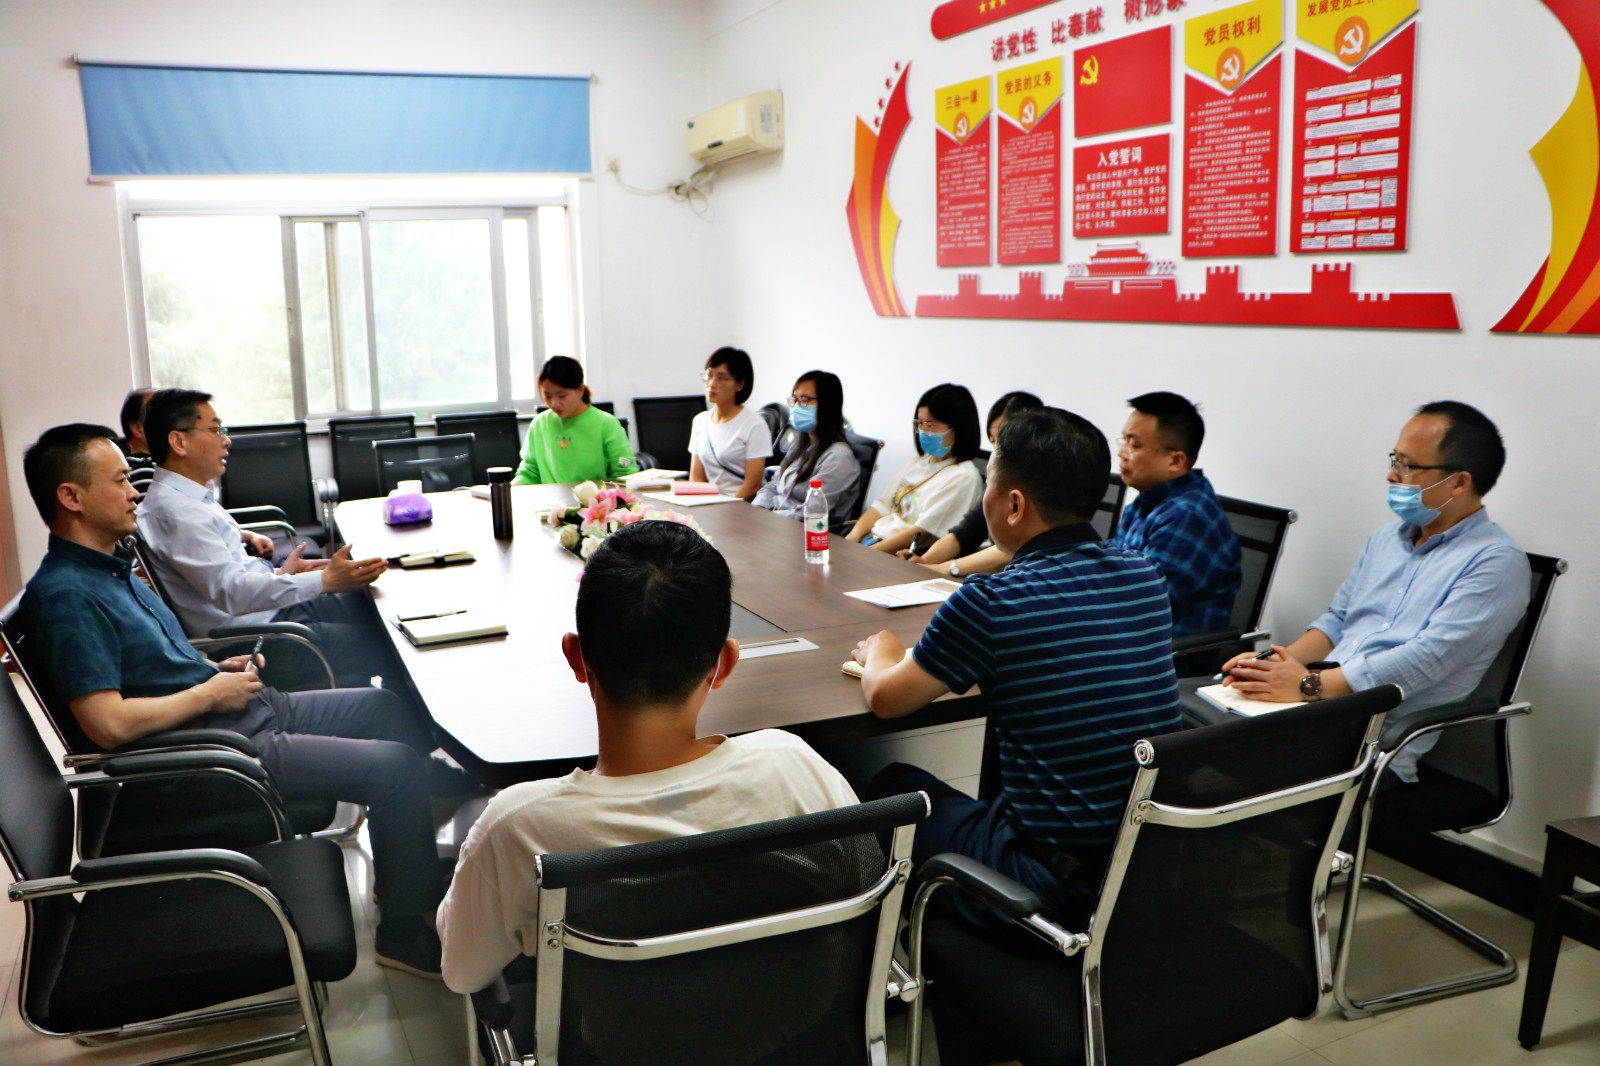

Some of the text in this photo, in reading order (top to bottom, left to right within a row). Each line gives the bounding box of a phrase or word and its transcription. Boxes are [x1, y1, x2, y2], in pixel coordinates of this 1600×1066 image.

[1307, 0, 1374, 17] 发展党员
[991, 26, 1037, 61] 讲党性
[1051, 6, 1103, 43] 比奉献
[1203, 14, 1261, 46] 党员权利
[1005, 71, 1052, 95] 党员的义务
[1097, 146, 1142, 167] 入党誓词
